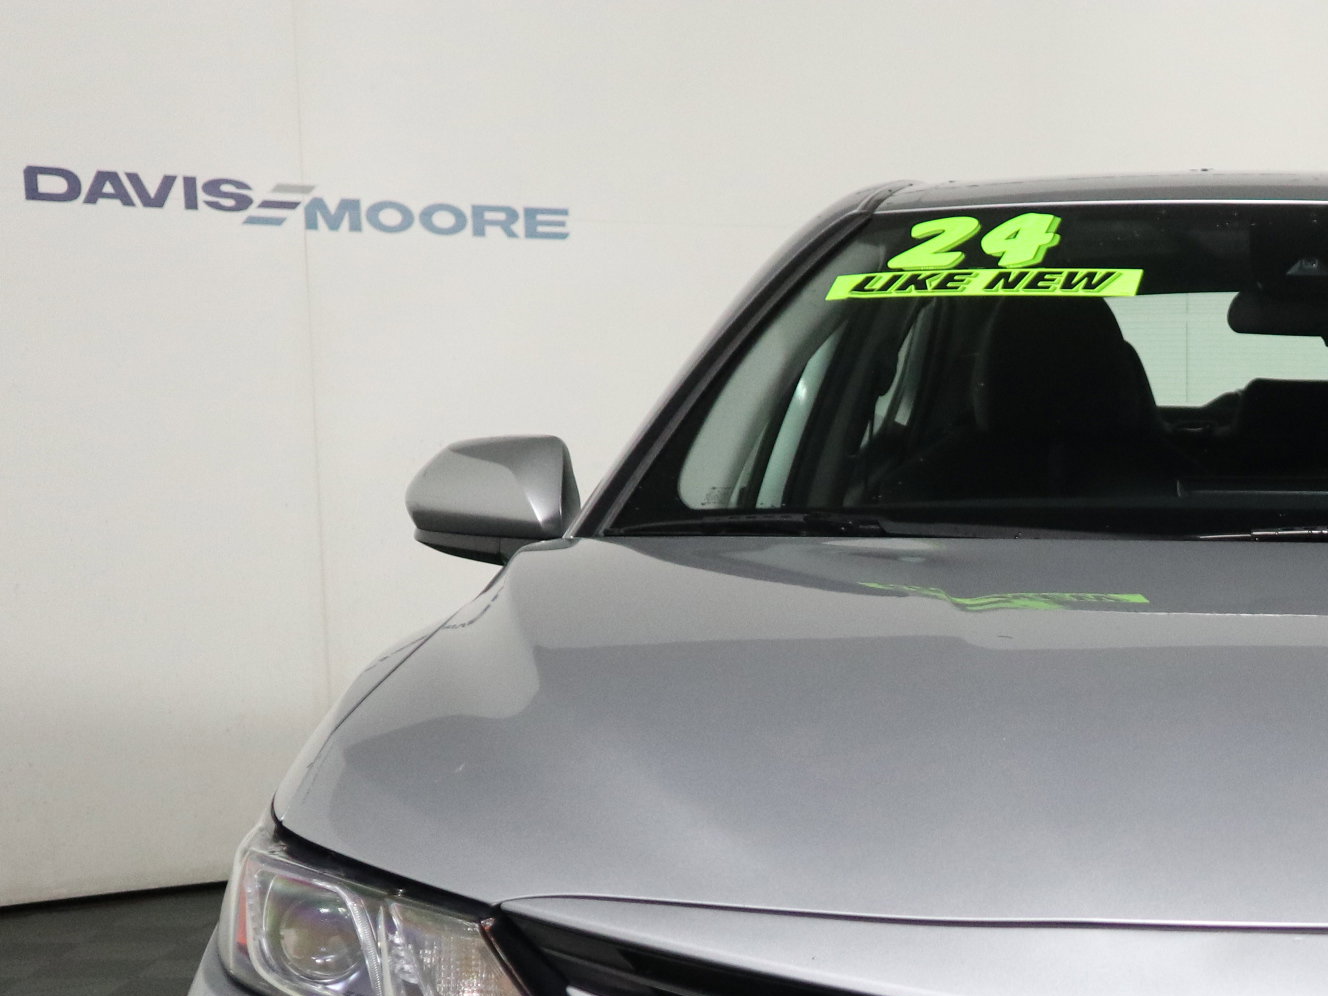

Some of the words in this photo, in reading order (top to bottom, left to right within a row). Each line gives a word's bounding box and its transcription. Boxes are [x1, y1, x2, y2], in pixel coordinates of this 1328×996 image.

[23, 165, 254, 212] DAVIS
[303, 197, 570, 240] MOORE
[887, 213, 1060, 270] 24
[850, 272, 976, 294] LIKE
[984, 271, 1119, 294] NEW
